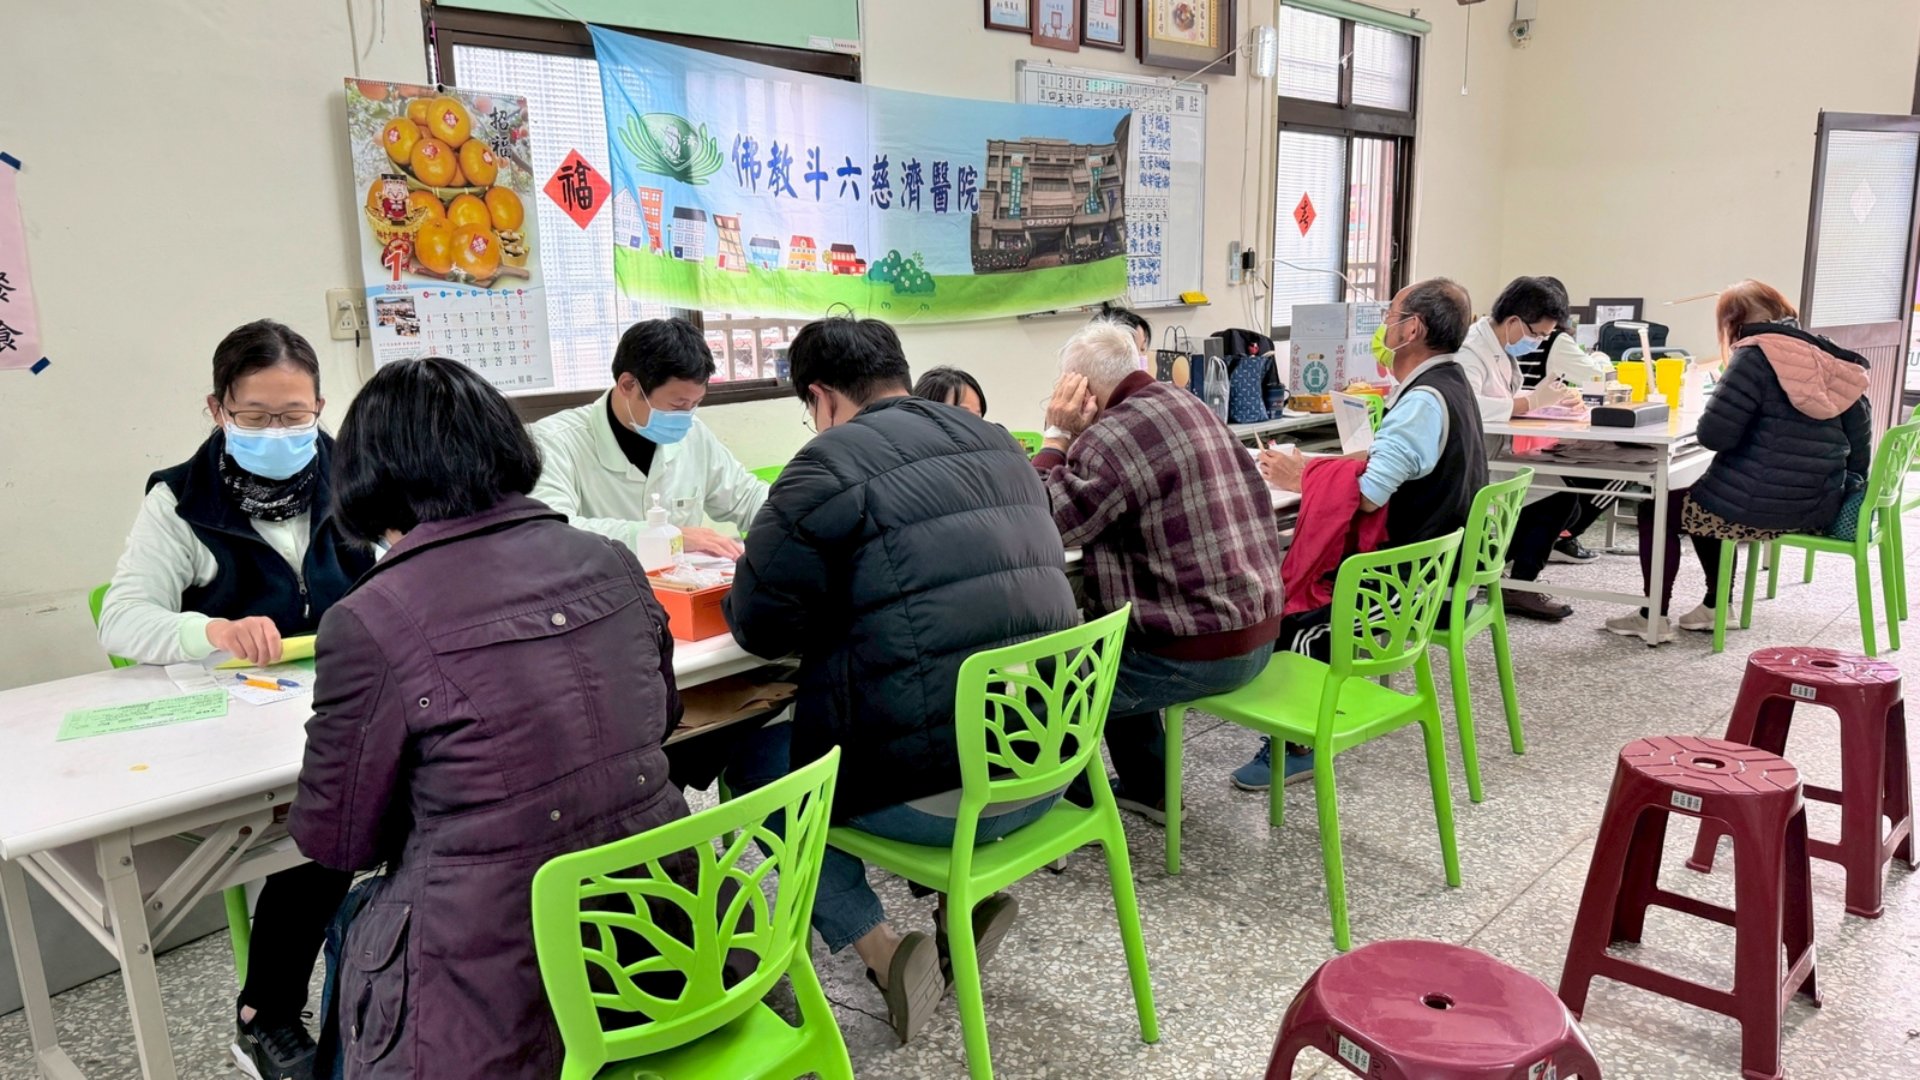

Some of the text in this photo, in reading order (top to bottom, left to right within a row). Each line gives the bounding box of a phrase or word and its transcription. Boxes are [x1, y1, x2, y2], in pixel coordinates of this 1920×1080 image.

[489, 106, 512, 158] 招福
[731, 132, 979, 214] 佛教斗六慈濟醫院
[558, 160, 594, 212] 福
[385, 250, 402, 282] 1
[520, 311, 526, 319] 10
[445, 330, 451, 339] 12
[461, 329, 468, 338] 13
[476, 328, 483, 337] 14
[492, 327, 498, 336] 15
[507, 327, 514, 335] 16
[522, 326, 528, 335] 17
[446, 345, 453, 354] 19
[462, 344, 470, 353] 20
[478, 344, 485, 352] 21
[493, 343, 500, 351] 22
[509, 342, 515, 350] 23
[523, 341, 530, 349] 24
[480, 358, 487, 367] 28
[496, 357, 502, 366] 29
